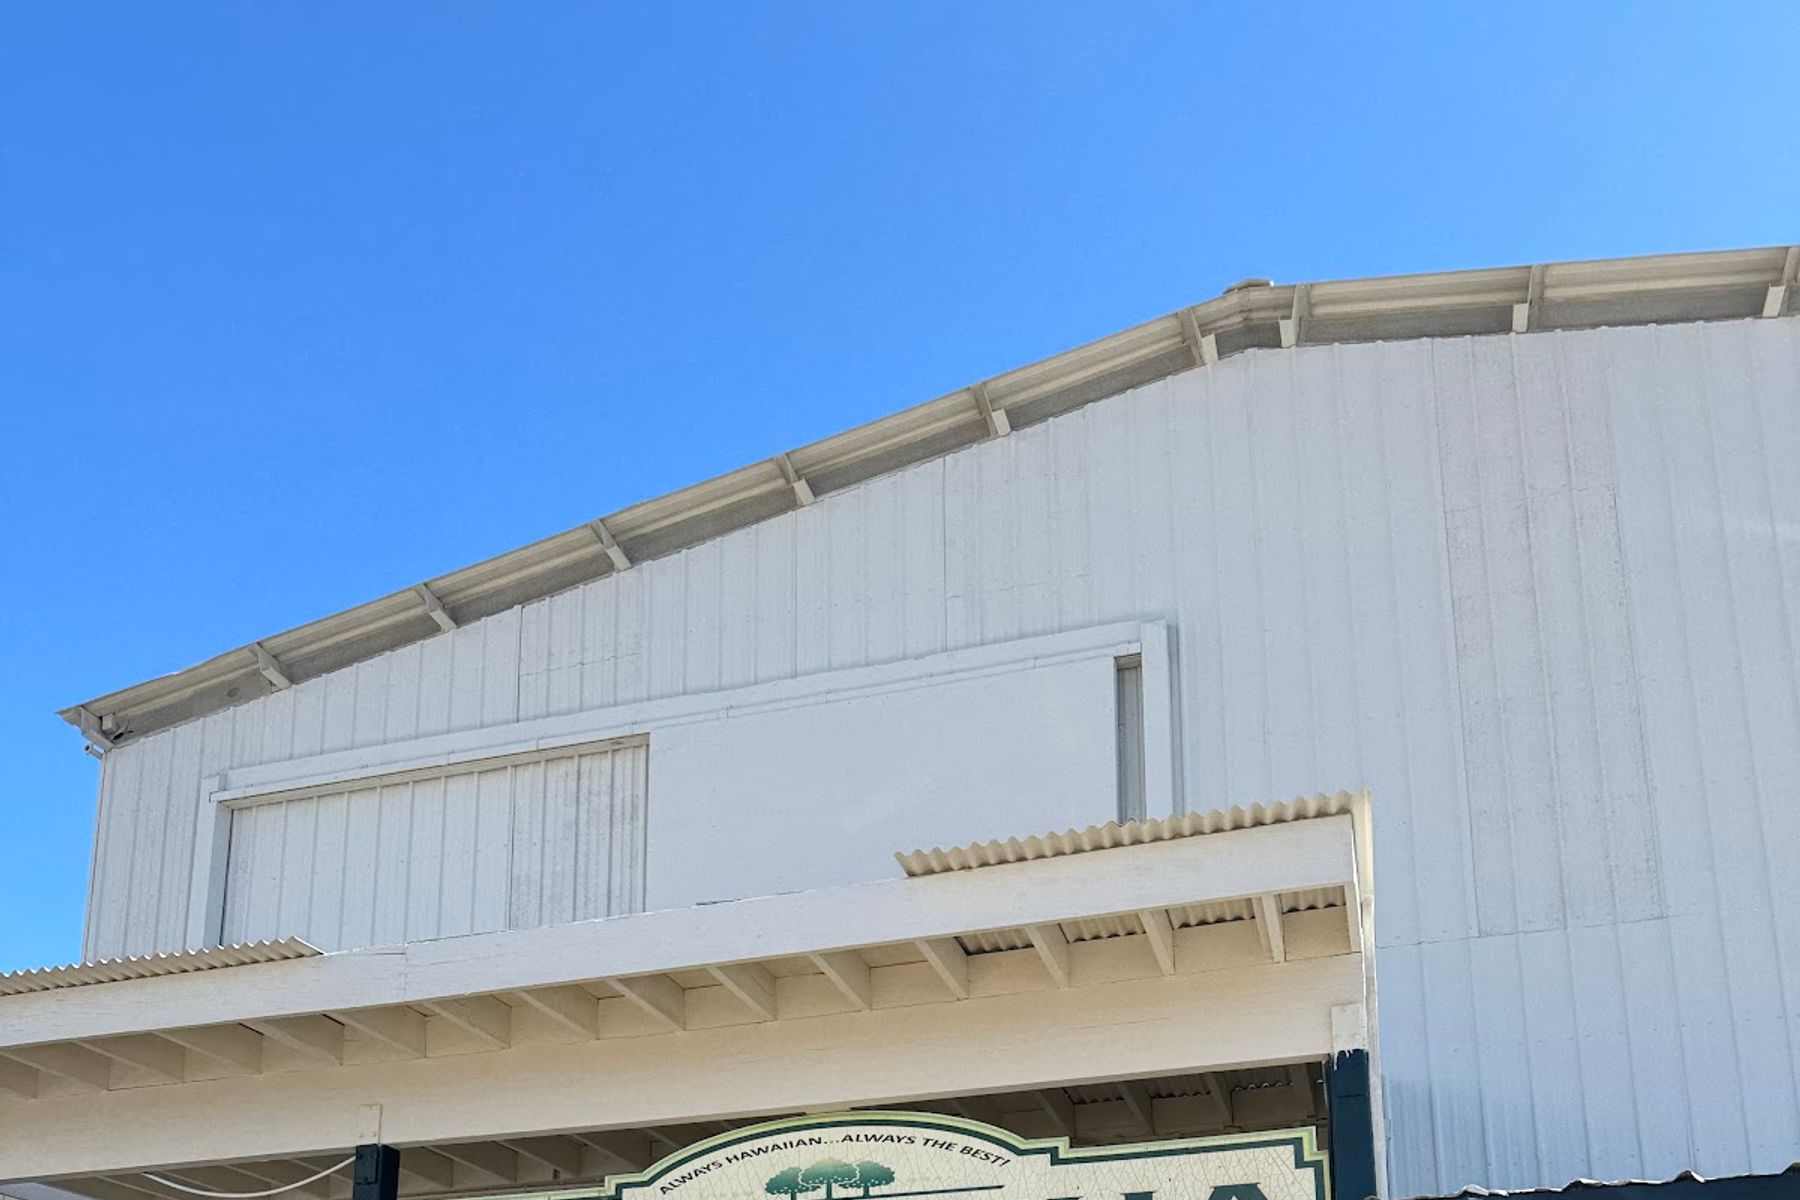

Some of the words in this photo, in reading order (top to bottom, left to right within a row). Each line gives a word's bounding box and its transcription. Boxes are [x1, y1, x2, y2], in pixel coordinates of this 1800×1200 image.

[659, 1160, 723, 1196] ALWAYS
[921, 1136, 958, 1152] THE
[959, 1145, 1012, 1168] BEST!
